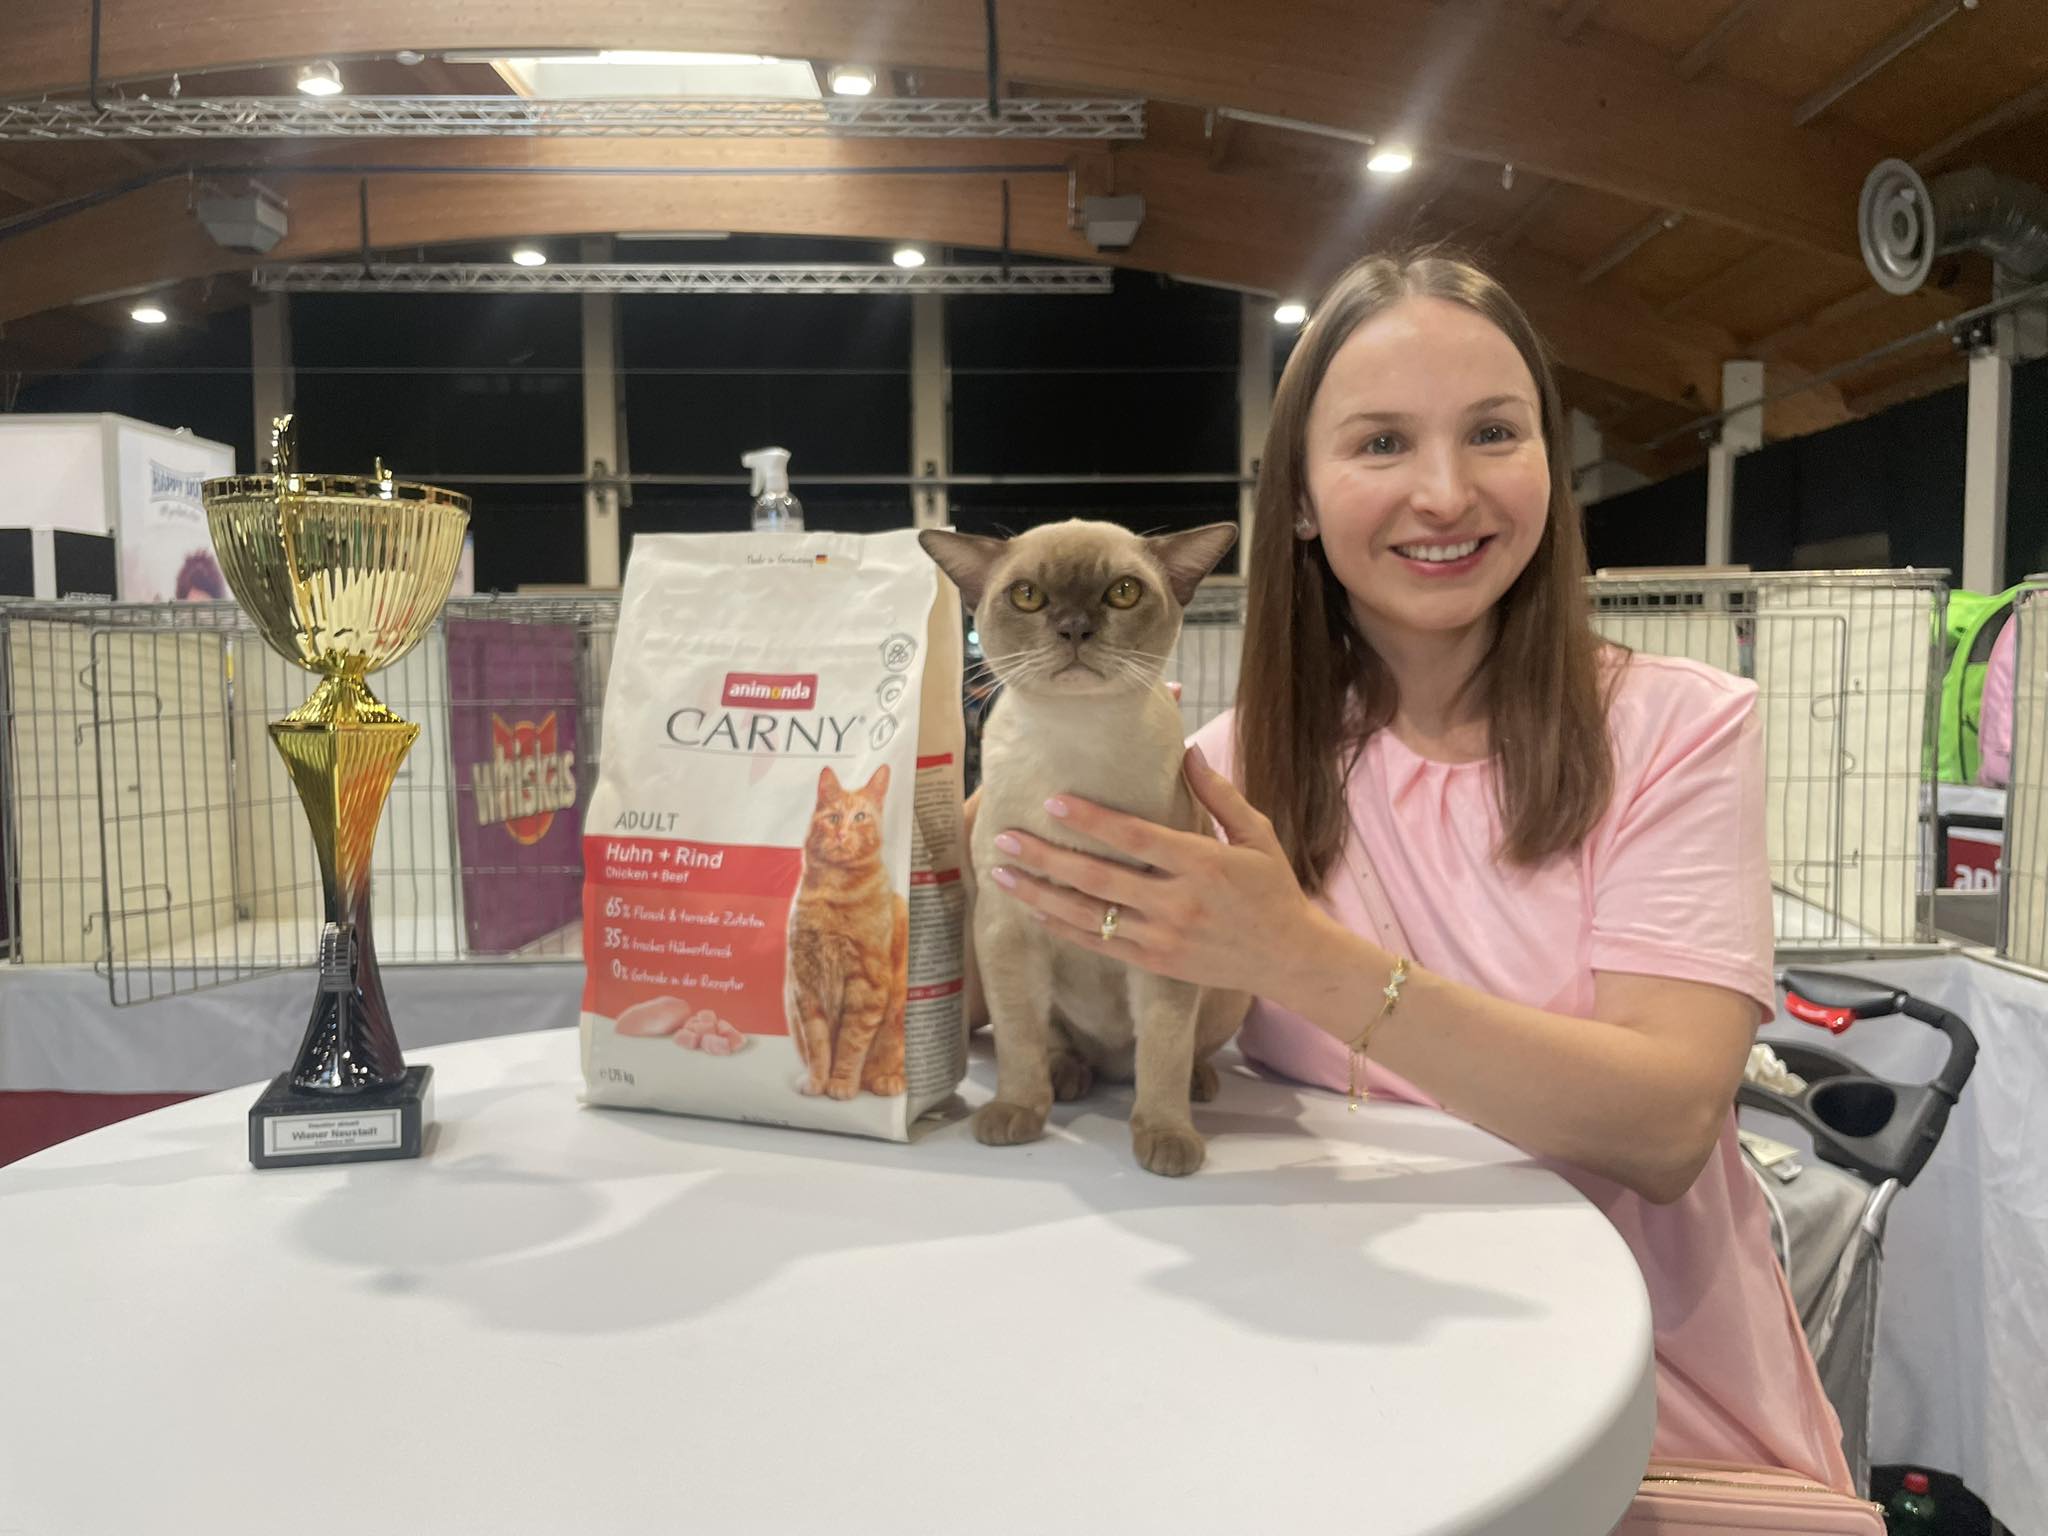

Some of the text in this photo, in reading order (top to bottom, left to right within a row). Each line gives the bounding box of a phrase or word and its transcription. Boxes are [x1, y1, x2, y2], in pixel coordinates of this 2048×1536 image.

[729, 680, 811, 700] animonda
[614, 811, 680, 832] ADULT
[605, 842, 724, 870] Huhn + Rind
[605, 866, 690, 884] Chicken + Beef
[291, 1126, 378, 1141] Wiener Neustadt
